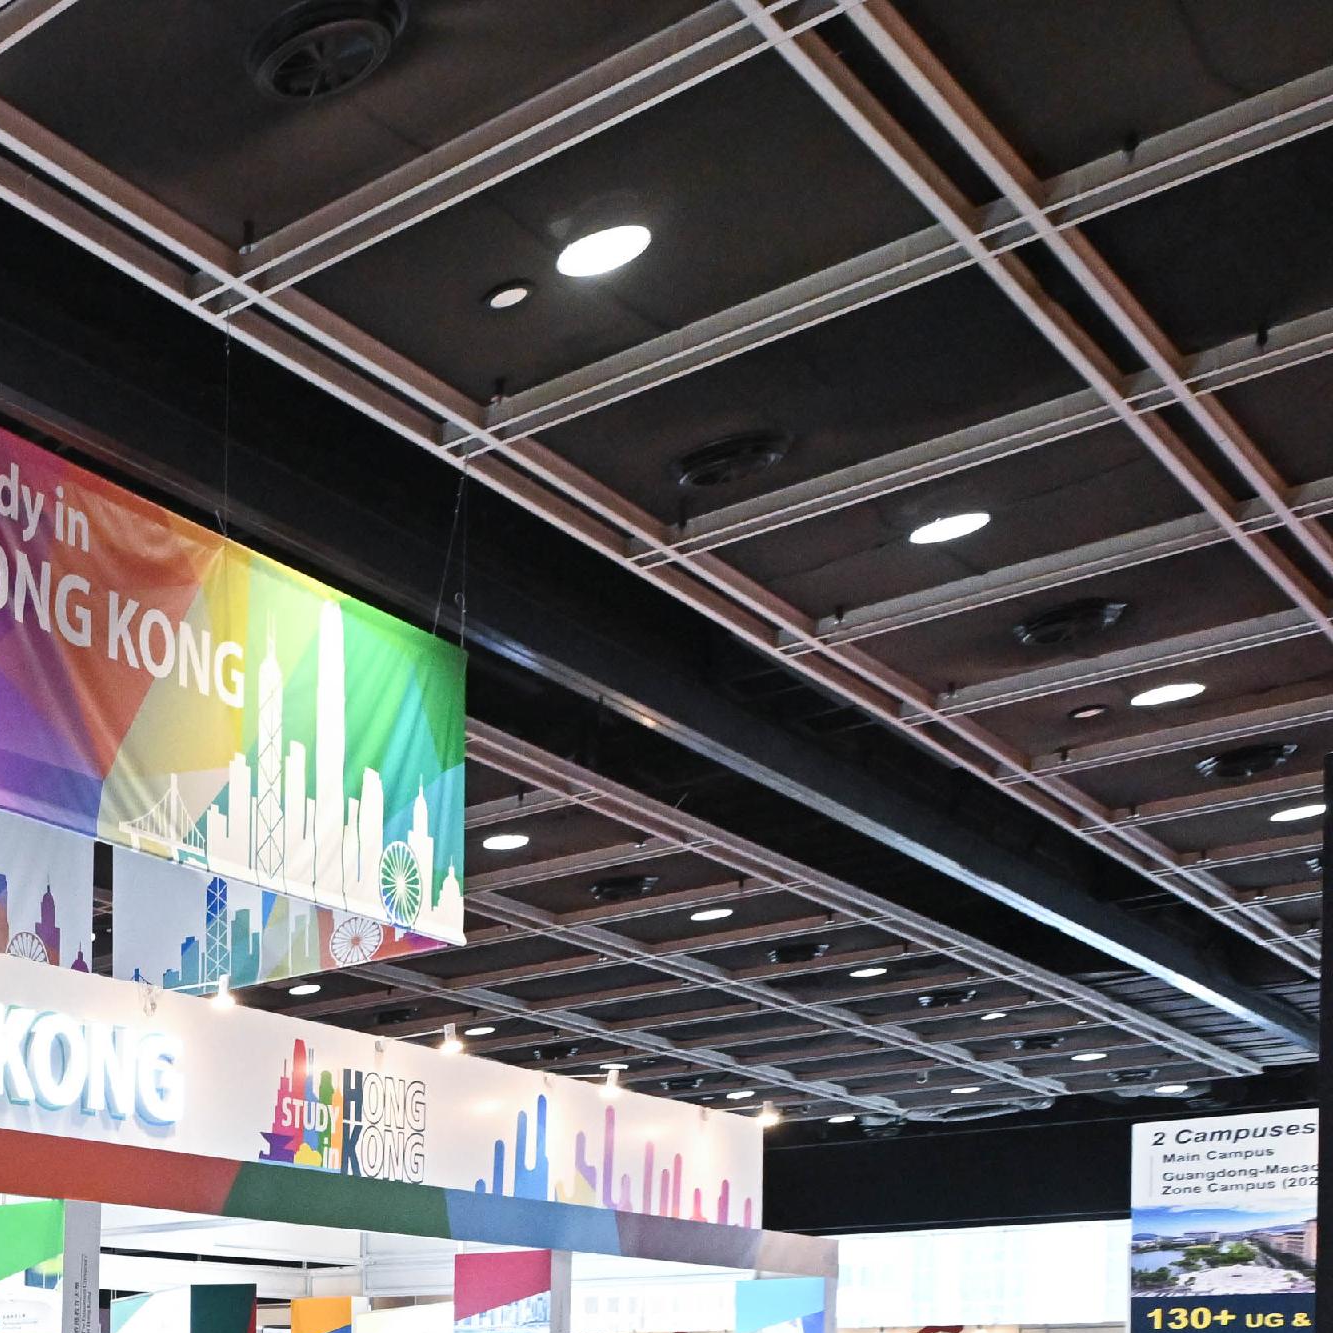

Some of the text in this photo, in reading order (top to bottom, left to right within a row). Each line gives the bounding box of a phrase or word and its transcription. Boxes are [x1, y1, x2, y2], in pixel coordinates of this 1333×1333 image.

[54, 486, 89, 552] in
[108, 599, 245, 708] KONG
[343, 1069, 425, 1132] HONG
[282, 1097, 425, 1183] STUDY KONG
[1152, 1122, 1316, 1146] 2 Campuses
[323, 1137, 339, 1168] in
[1163, 1148, 1274, 1163] Main Campus
[1162, 1185, 1201, 1195] Zone
[1208, 1180, 1275, 1192] Campus
[1147, 1307, 1312, 1331] 130+ UG &
